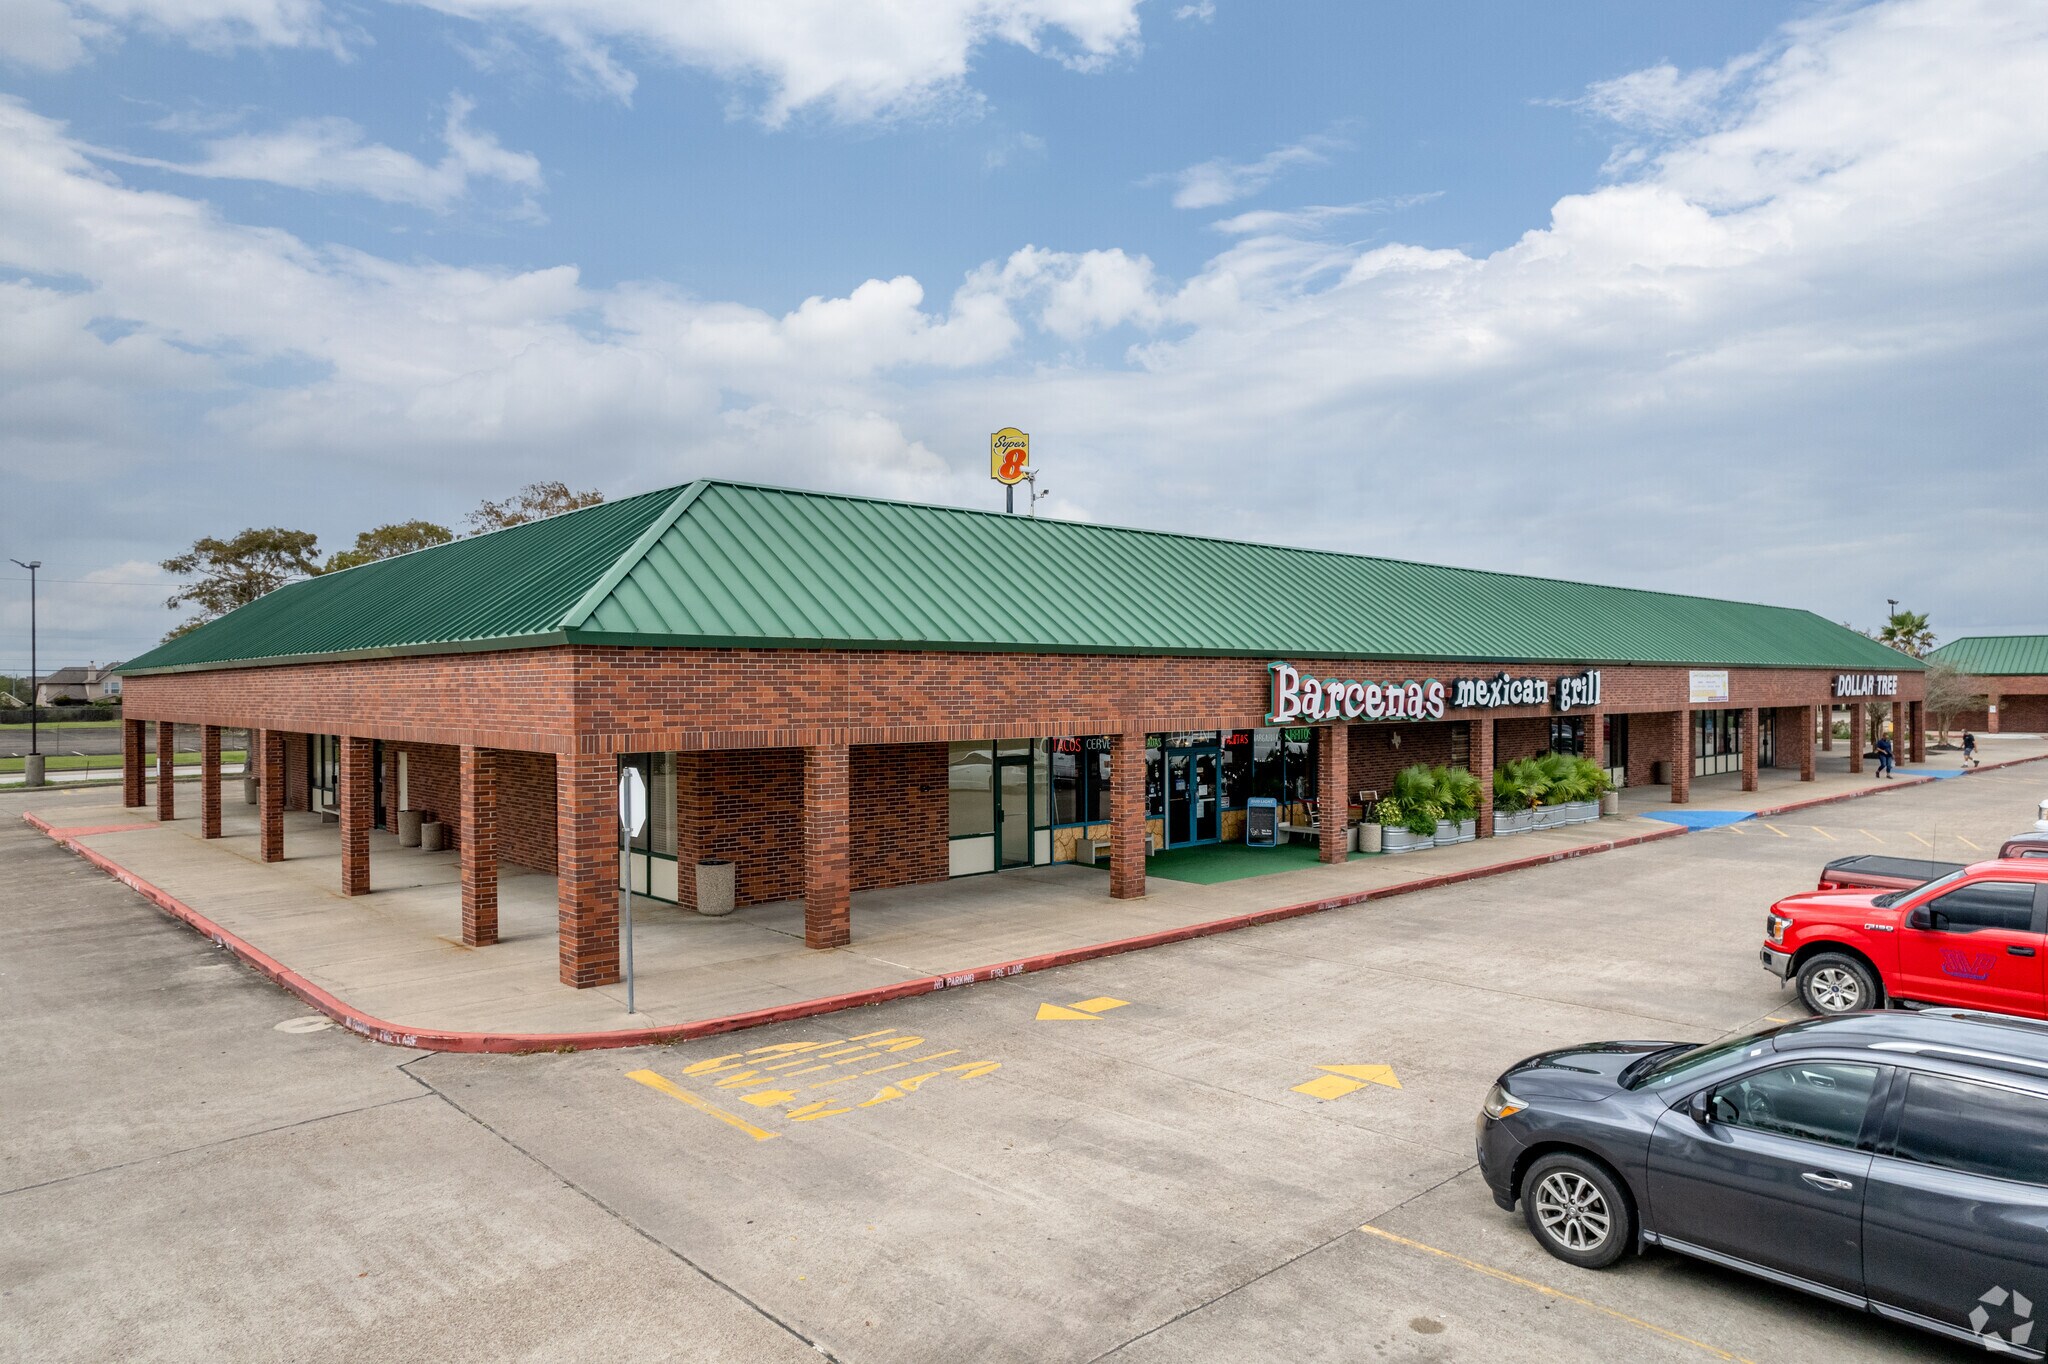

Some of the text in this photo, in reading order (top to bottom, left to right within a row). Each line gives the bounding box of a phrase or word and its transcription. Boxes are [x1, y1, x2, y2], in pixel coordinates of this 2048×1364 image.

[994, 435, 1027, 454] Super
[999, 448, 1027, 480] 8
[1272, 663, 1602, 723] Barcenas mexican grill
[1837, 674, 1898, 697] DOLLAR TREE
[1052, 737, 1082, 752] TACOS
[934, 963, 1024, 990] NO PARKING FIRE LANE
